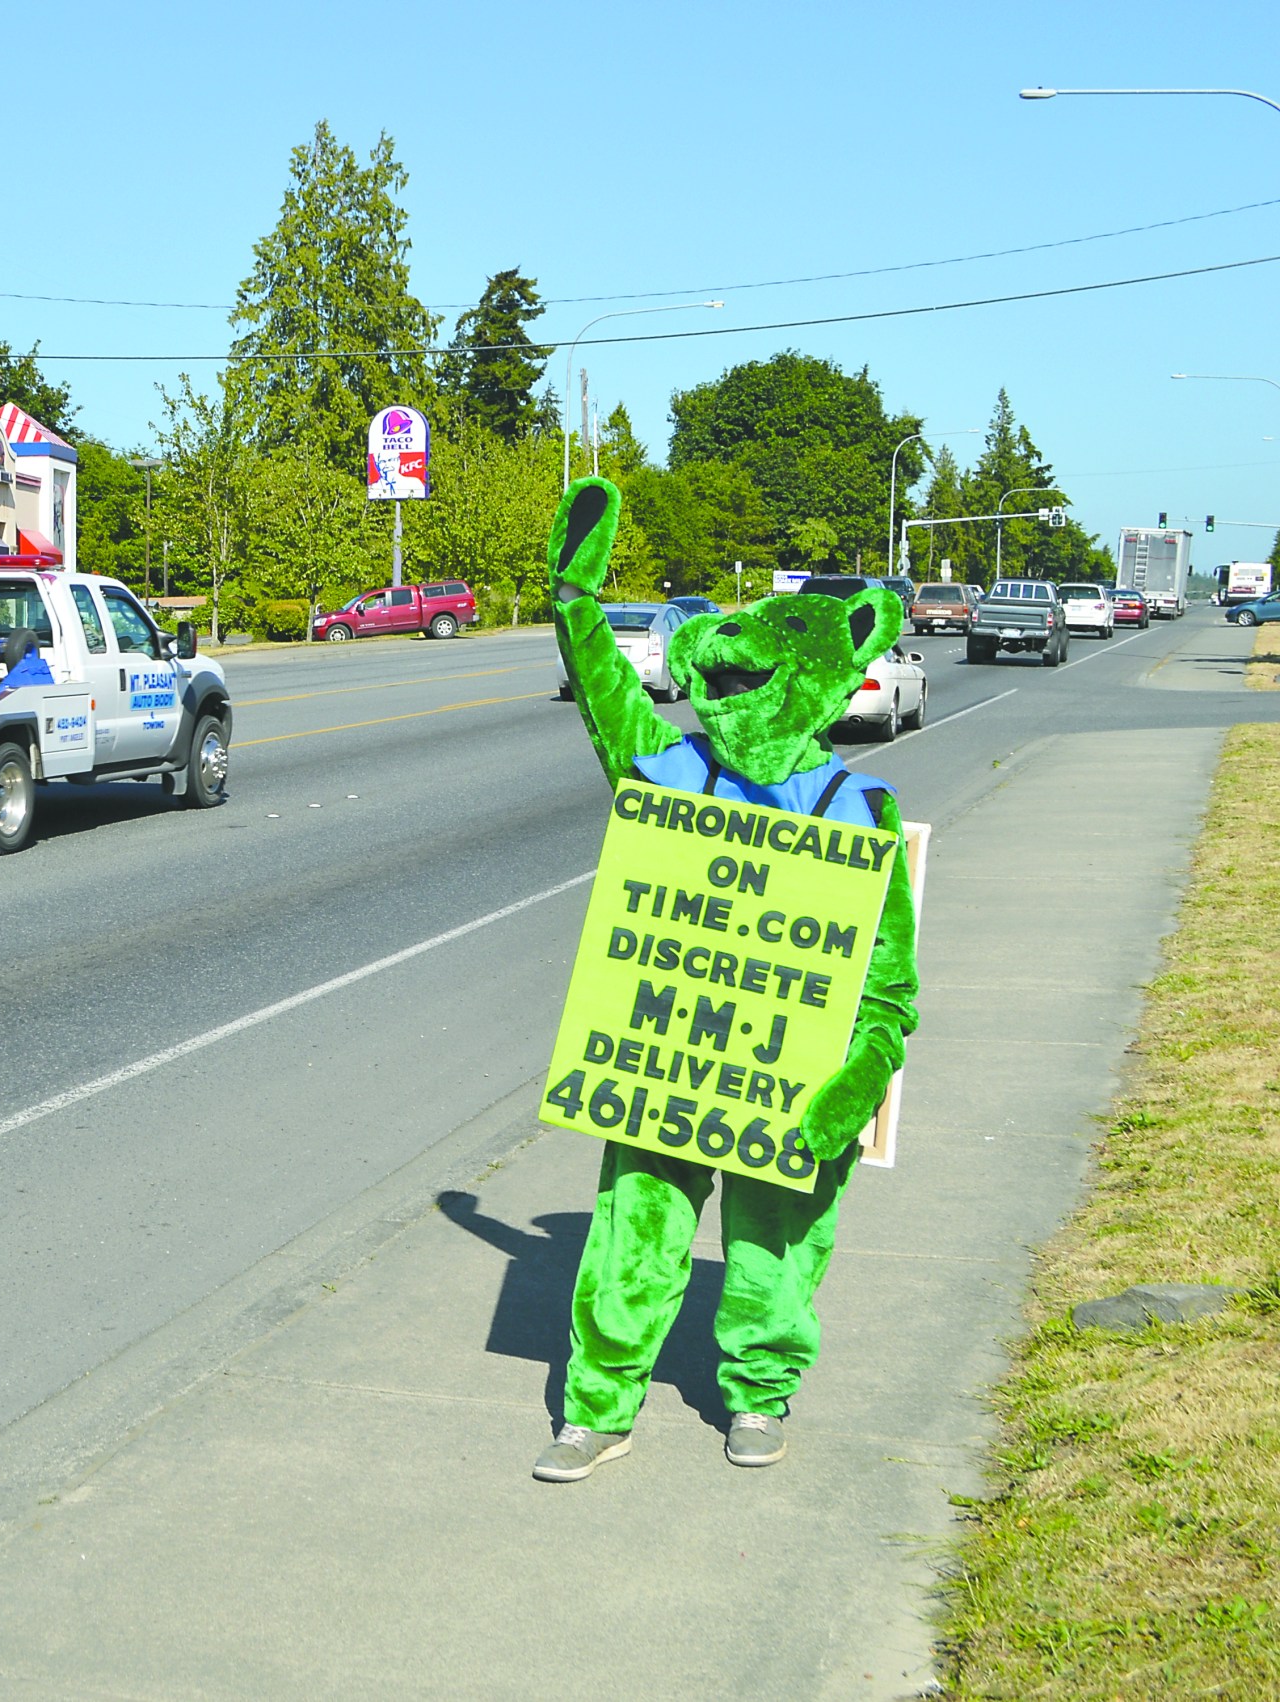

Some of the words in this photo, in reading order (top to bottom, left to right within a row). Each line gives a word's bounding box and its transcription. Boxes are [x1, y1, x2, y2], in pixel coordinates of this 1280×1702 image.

[400, 458, 423, 474] KFC
[131, 695, 152, 708] AUTO
[153, 693, 174, 707] BODY
[143, 672, 177, 690] PLEASANT
[614, 789, 896, 872] CHRONICALLY
[707, 856, 770, 896] ON
[623, 879, 858, 958] TIME.COM
[607, 926, 832, 1008] DISCRETE
[583, 1030, 806, 1114] DELIVERY
